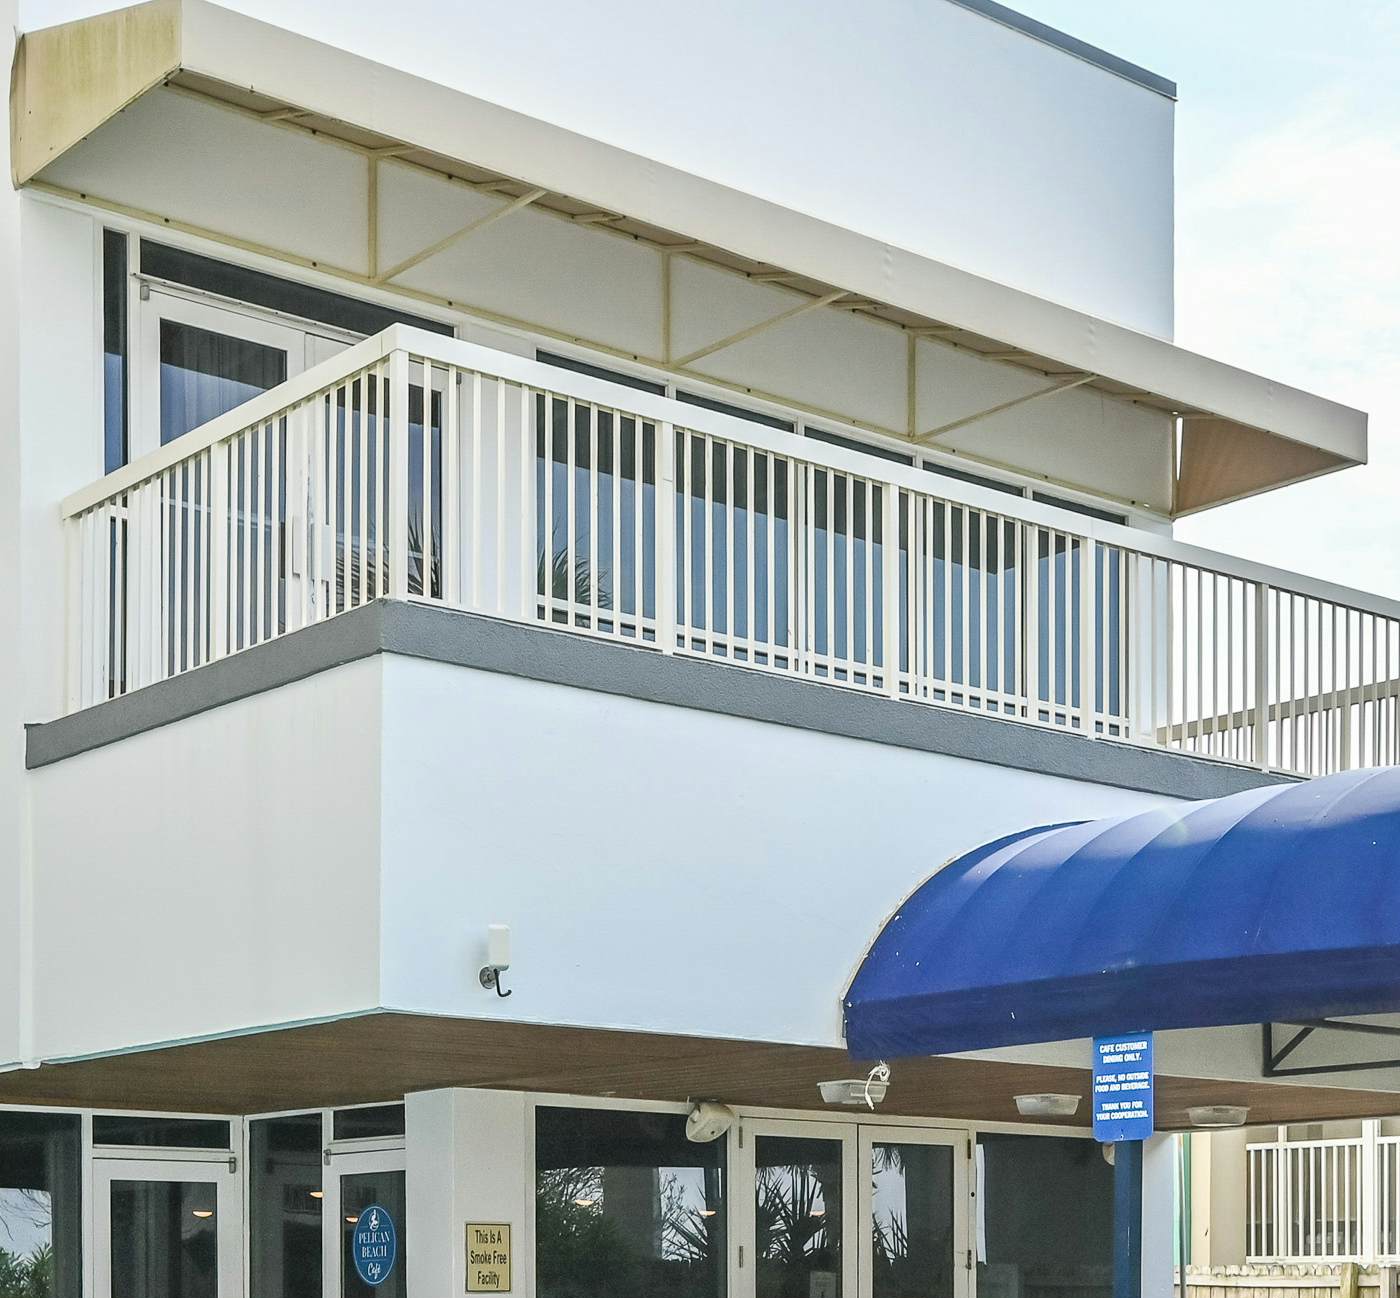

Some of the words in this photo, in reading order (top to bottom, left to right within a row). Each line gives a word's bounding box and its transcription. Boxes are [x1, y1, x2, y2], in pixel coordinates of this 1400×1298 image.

[1100, 1044, 1115, 1053] CAFE
[1115, 1041, 1147, 1051] CUSTOMER
[1103, 1054, 1123, 1063] DINING
[1123, 1053, 1142, 1062] ONLY.
[1117, 1073, 1126, 1082] NO
[1126, 1072, 1149, 1080] OUTSIDE
[1095, 1085, 1109, 1093] FOOD
[1109, 1083, 1120, 1092] AND
[1102, 1102, 1119, 1111] THANK
[1119, 1101, 1131, 1109] YOU
[1131, 1100, 1143, 1108] FOR
[1096, 1112, 1110, 1121] YOUR
[358, 1231, 391, 1244] PELICAN
[475, 1229, 488, 1244] This
[489, 1229, 496, 1244] Is
[497, 1230, 502, 1244] A
[362, 1245, 388, 1258] BEACH
[470, 1249, 492, 1265] Smoke
[493, 1249, 508, 1265] Free
[477, 1270, 501, 1289] Facility
